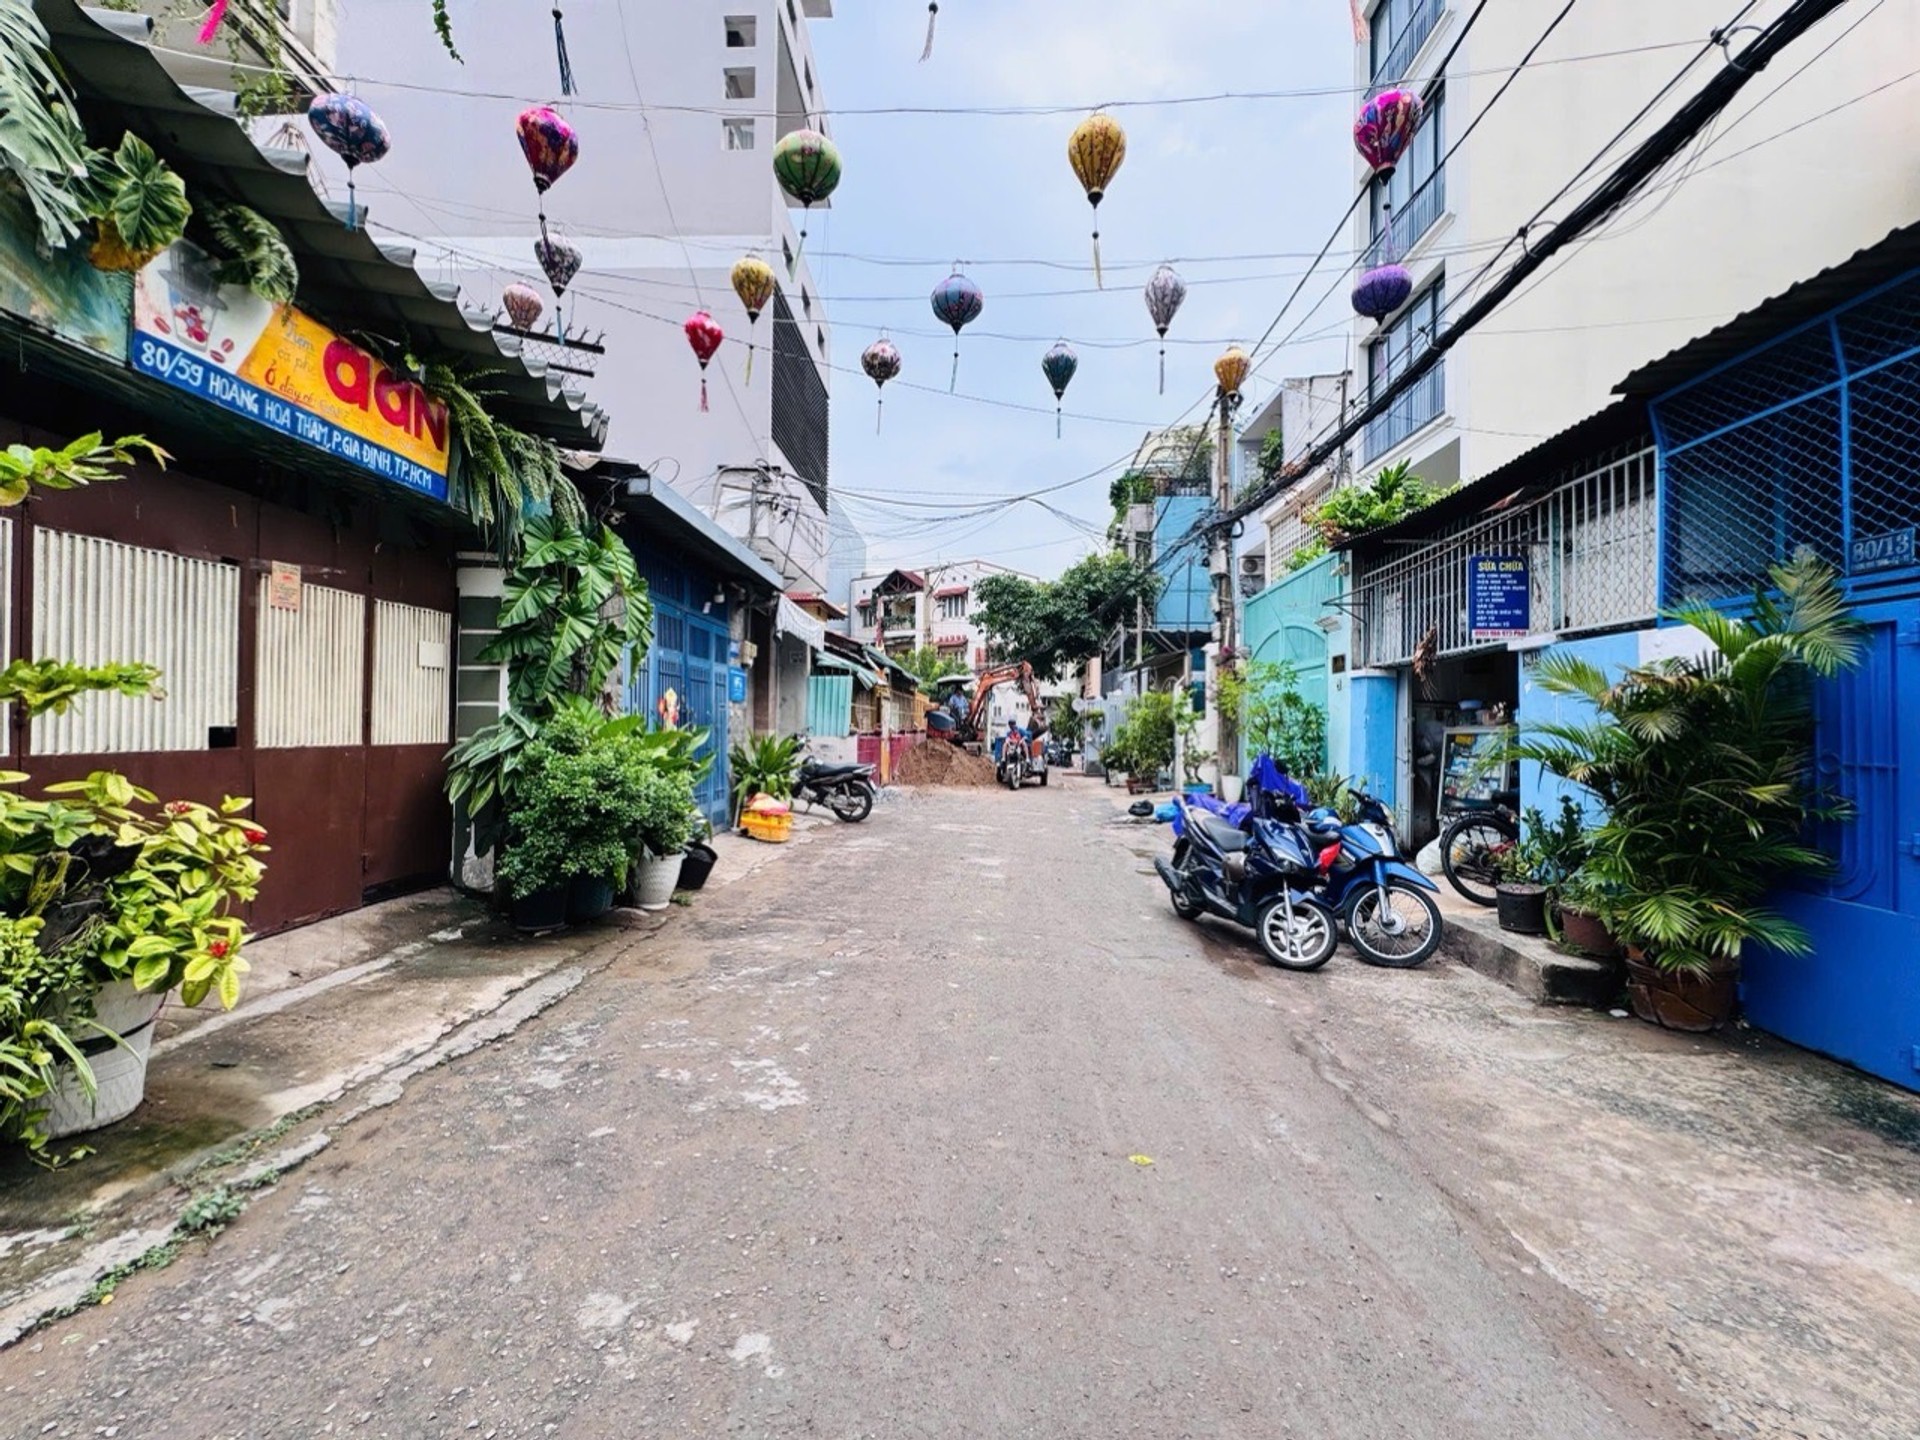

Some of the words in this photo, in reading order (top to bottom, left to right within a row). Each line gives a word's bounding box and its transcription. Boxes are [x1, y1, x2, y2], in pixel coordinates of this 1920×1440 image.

[140, 340, 204, 387] 80/59
[264, 397, 290, 429] HOA
[1852, 532, 1909, 563] 80/13
